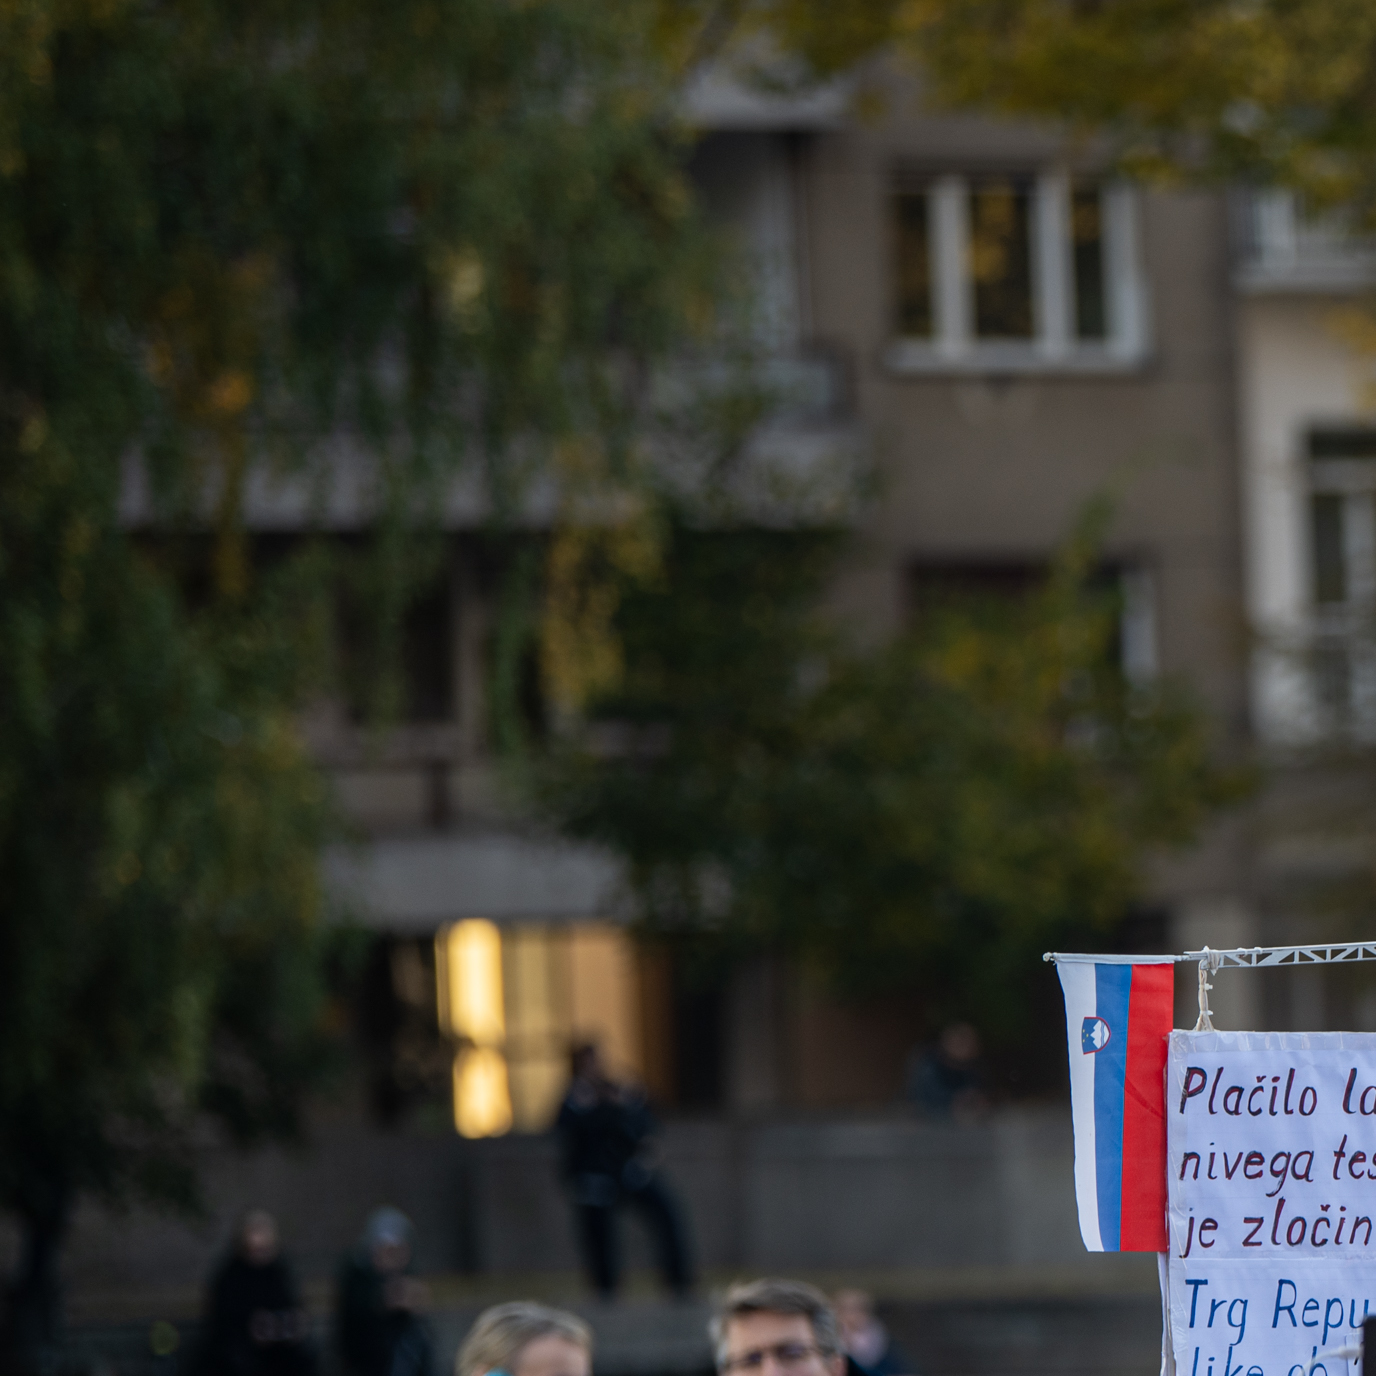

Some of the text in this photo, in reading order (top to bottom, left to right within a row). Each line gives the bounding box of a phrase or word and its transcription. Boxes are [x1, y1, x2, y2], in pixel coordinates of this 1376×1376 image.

[1180, 1067, 1317, 1116] Plačilo
[1179, 1142, 1313, 1197] nivega
[1178, 1207, 1218, 1259] je
[1185, 1278, 1249, 1345] Trg
